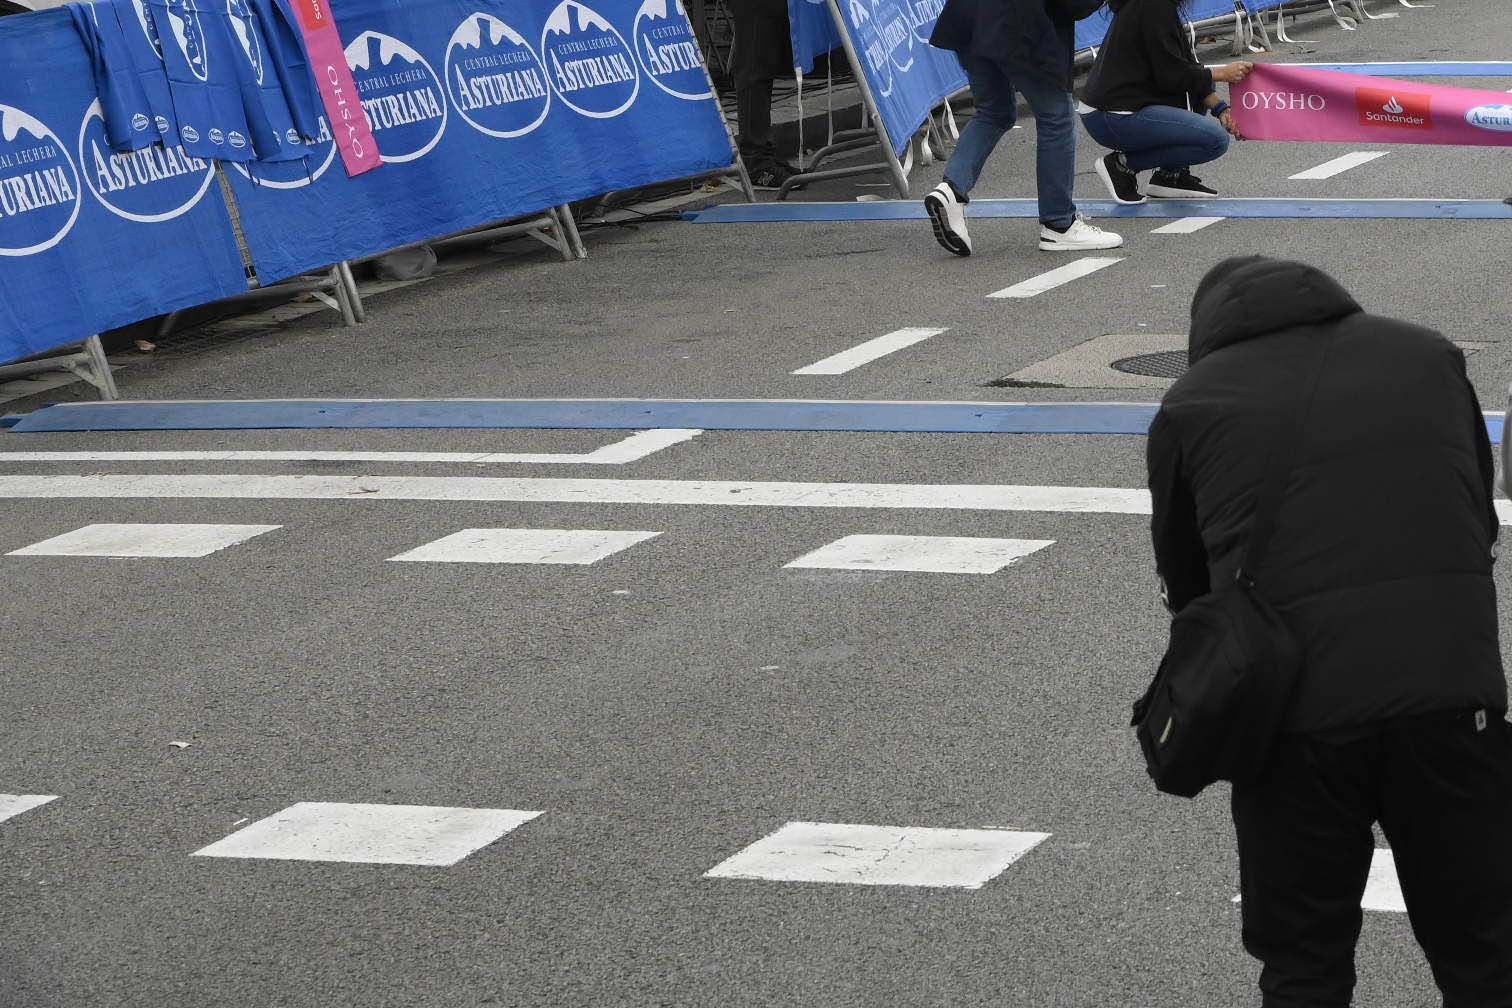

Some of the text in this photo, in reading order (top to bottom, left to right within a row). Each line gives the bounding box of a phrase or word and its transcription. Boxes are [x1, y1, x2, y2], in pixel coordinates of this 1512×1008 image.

[653, 25, 682, 40] CENTRAL
[558, 36, 618, 56] CENTRAL LECHERA
[464, 50, 531, 71] CENTRAL LECHERA
[549, 47, 635, 93] ASTURIANA
[389, 69, 427, 87] LECHERA
[454, 63, 547, 111] ASTURIANA
[1242, 91, 1326, 111] OYSHO
[327, 65, 364, 159] OYSHO
[1366, 111, 1425, 125] Santander
[15, 145, 56, 164] LECHERA
[0, 165, 76, 218] URIANA
